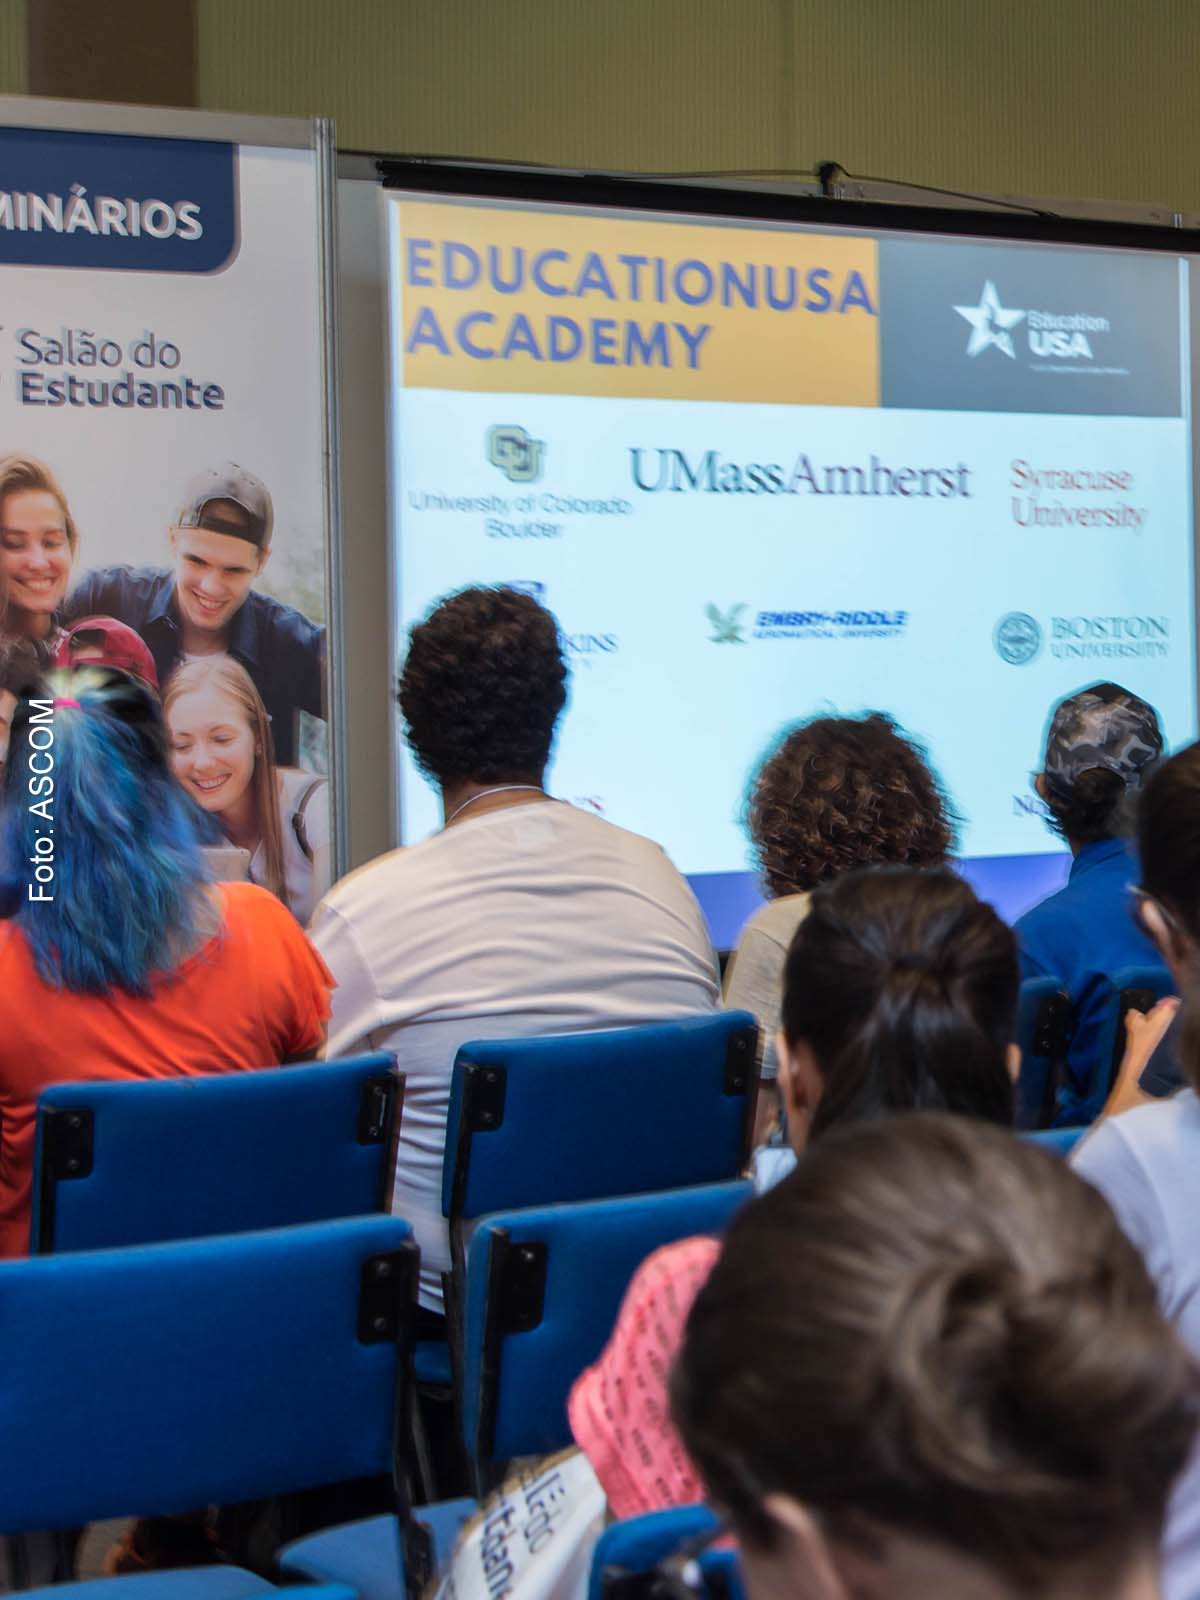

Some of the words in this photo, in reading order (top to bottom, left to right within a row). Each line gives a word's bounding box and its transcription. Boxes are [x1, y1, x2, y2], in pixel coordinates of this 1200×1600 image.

[404, 236, 878, 316] EDUCATIONUSA
[17, 326, 123, 369] Salão
[130, 328, 182, 370] do
[404, 306, 712, 370] ACADEMY
[1028, 330, 1094, 359] USA
[18, 369, 226, 411] Estudante
[1010, 458, 1134, 496] Syracuse
[408, 489, 510, 516] University
[517, 494, 538, 514] of
[541, 493, 633, 516] Colorado
[1010, 496, 1149, 536] University
[560, 633, 619, 654] KINS
[1051, 615, 1171, 640] BOSTON
[1051, 640, 1169, 659] UNIVERSITY
